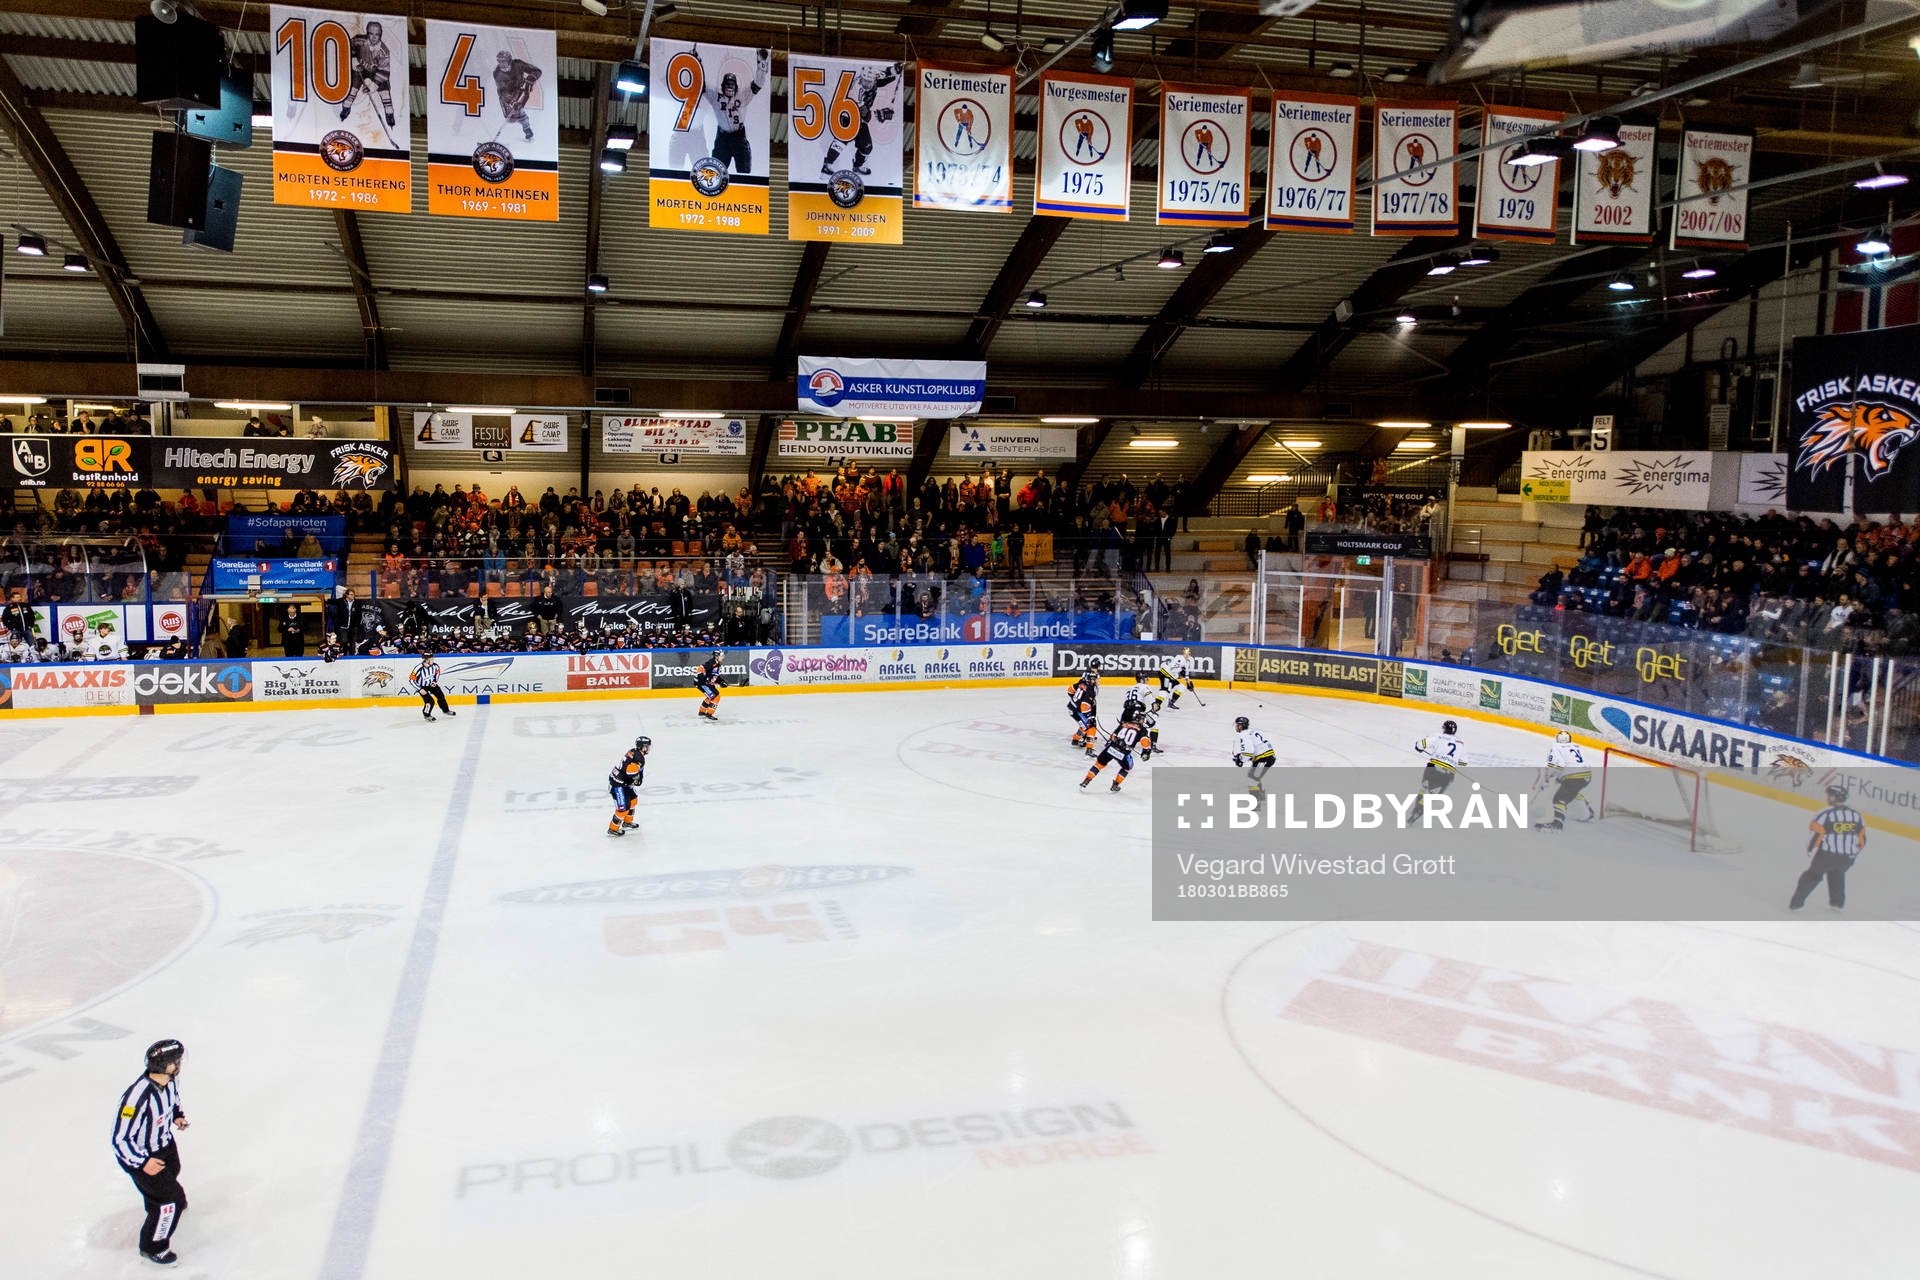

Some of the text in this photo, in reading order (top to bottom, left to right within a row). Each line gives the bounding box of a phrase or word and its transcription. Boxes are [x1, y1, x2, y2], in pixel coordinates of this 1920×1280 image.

[276, 18, 352, 104] 10
[440, 33, 485, 118] 4
[924, 72, 1007, 95] Seriemester
[666, 52, 705, 132] 9
[1046, 82, 1128, 103] Norgesmester
[792, 67, 861, 142] 56
[1168, 95, 1244, 115] Seriemester
[1278, 102, 1352, 125] Seriemester
[1381, 108, 1452, 128] Seriemester
[1686, 133, 1750, 153] Seriemester
[279, 172, 406, 190] MORTEN SETHERENG
[1062, 171, 1104, 196] 1975
[308, 189, 379, 204] 1972 1986
[437, 184, 549, 201] THOR MARTINSEN
[1168, 179, 1240, 205] 1975/76
[462, 200, 527, 214] 1969 1981
[656, 198, 762, 214] MORTEN JOHANSEN
[1276, 187, 1346, 213] 1976/77
[1381, 191, 1449, 214] 1977/78
[1497, 197, 1534, 221] 1979
[1593, 205, 1632, 226] 2002
[679, 213, 741, 227] 1972 1988
[806, 211, 887, 224] JOHNNY NILSEN
[1680, 210, 1742, 234] 2007/08
[817, 225, 876, 237] 1991 2009
[849, 383, 976, 396] ASKER KUNSTLØPKLUBB
[1795, 376, 1852, 413] FRISK
[441, 419, 459, 427] SURF
[623, 418, 712, 428] SLEMMESTAD
[1595, 417, 1611, 425] FELT
[440, 429, 461, 437] CAMP
[542, 430, 561, 438] CAMP
[644, 428, 665, 436] BIL
[794, 421, 898, 443] PEAB
[330, 443, 389, 459] FRISK ASKER
[482, 450, 504, 462] Q
[779, 445, 913, 456] EIENDOMSUTVIKLING
[990, 445, 1031, 453] SENTER
[164, 448, 315, 475] Hitech Energy
[660, 453, 679, 464] Q
[72, 472, 139, 481] BestRenhold
[197, 475, 282, 487] energy saving
[1551, 468, 1606, 482] energima
[1643, 469, 1710, 486] energima
[247, 518, 327, 530] #Sofapatrioten
[1337, 541, 1381, 549] HOLTSMARK
[216, 561, 257, 569] SpareBank
[283, 561, 323, 569] SpareBank
[65, 620, 84, 630] RIIS
[163, 616, 181, 626] RIIS
[864, 620, 1077, 644] SpareBank 1 Østlandet
[568, 654, 649, 672] IKANO
[654, 663, 747, 677] Dressann
[879, 662, 917, 675] ARKEL
[924, 662, 962, 674] ARKEL
[969, 661, 1006, 673] ARKEL
[1013, 660, 1048, 671] ARKEL
[798, 672, 862, 683] superselma.no
[1260, 658, 1377, 684] ASKER TRELAST
[12, 669, 126, 690] MAXXIS
[134, 667, 218, 696] dekk
[264, 679, 339, 690] Big Horn
[586, 676, 631, 686] BANK
[1433, 678, 1477, 691] QUALITY HOTEL
[264, 687, 339, 696] Steak House
[463, 682, 544, 694] MARINE
[86, 691, 125, 702] DEKK
[1633, 714, 1768, 776] SKAARET
[503, 777, 777, 805] tripetex
[454, 1101, 1138, 1201] PROFIL DESIGN
[975, 1134, 1158, 1171] NORGE
